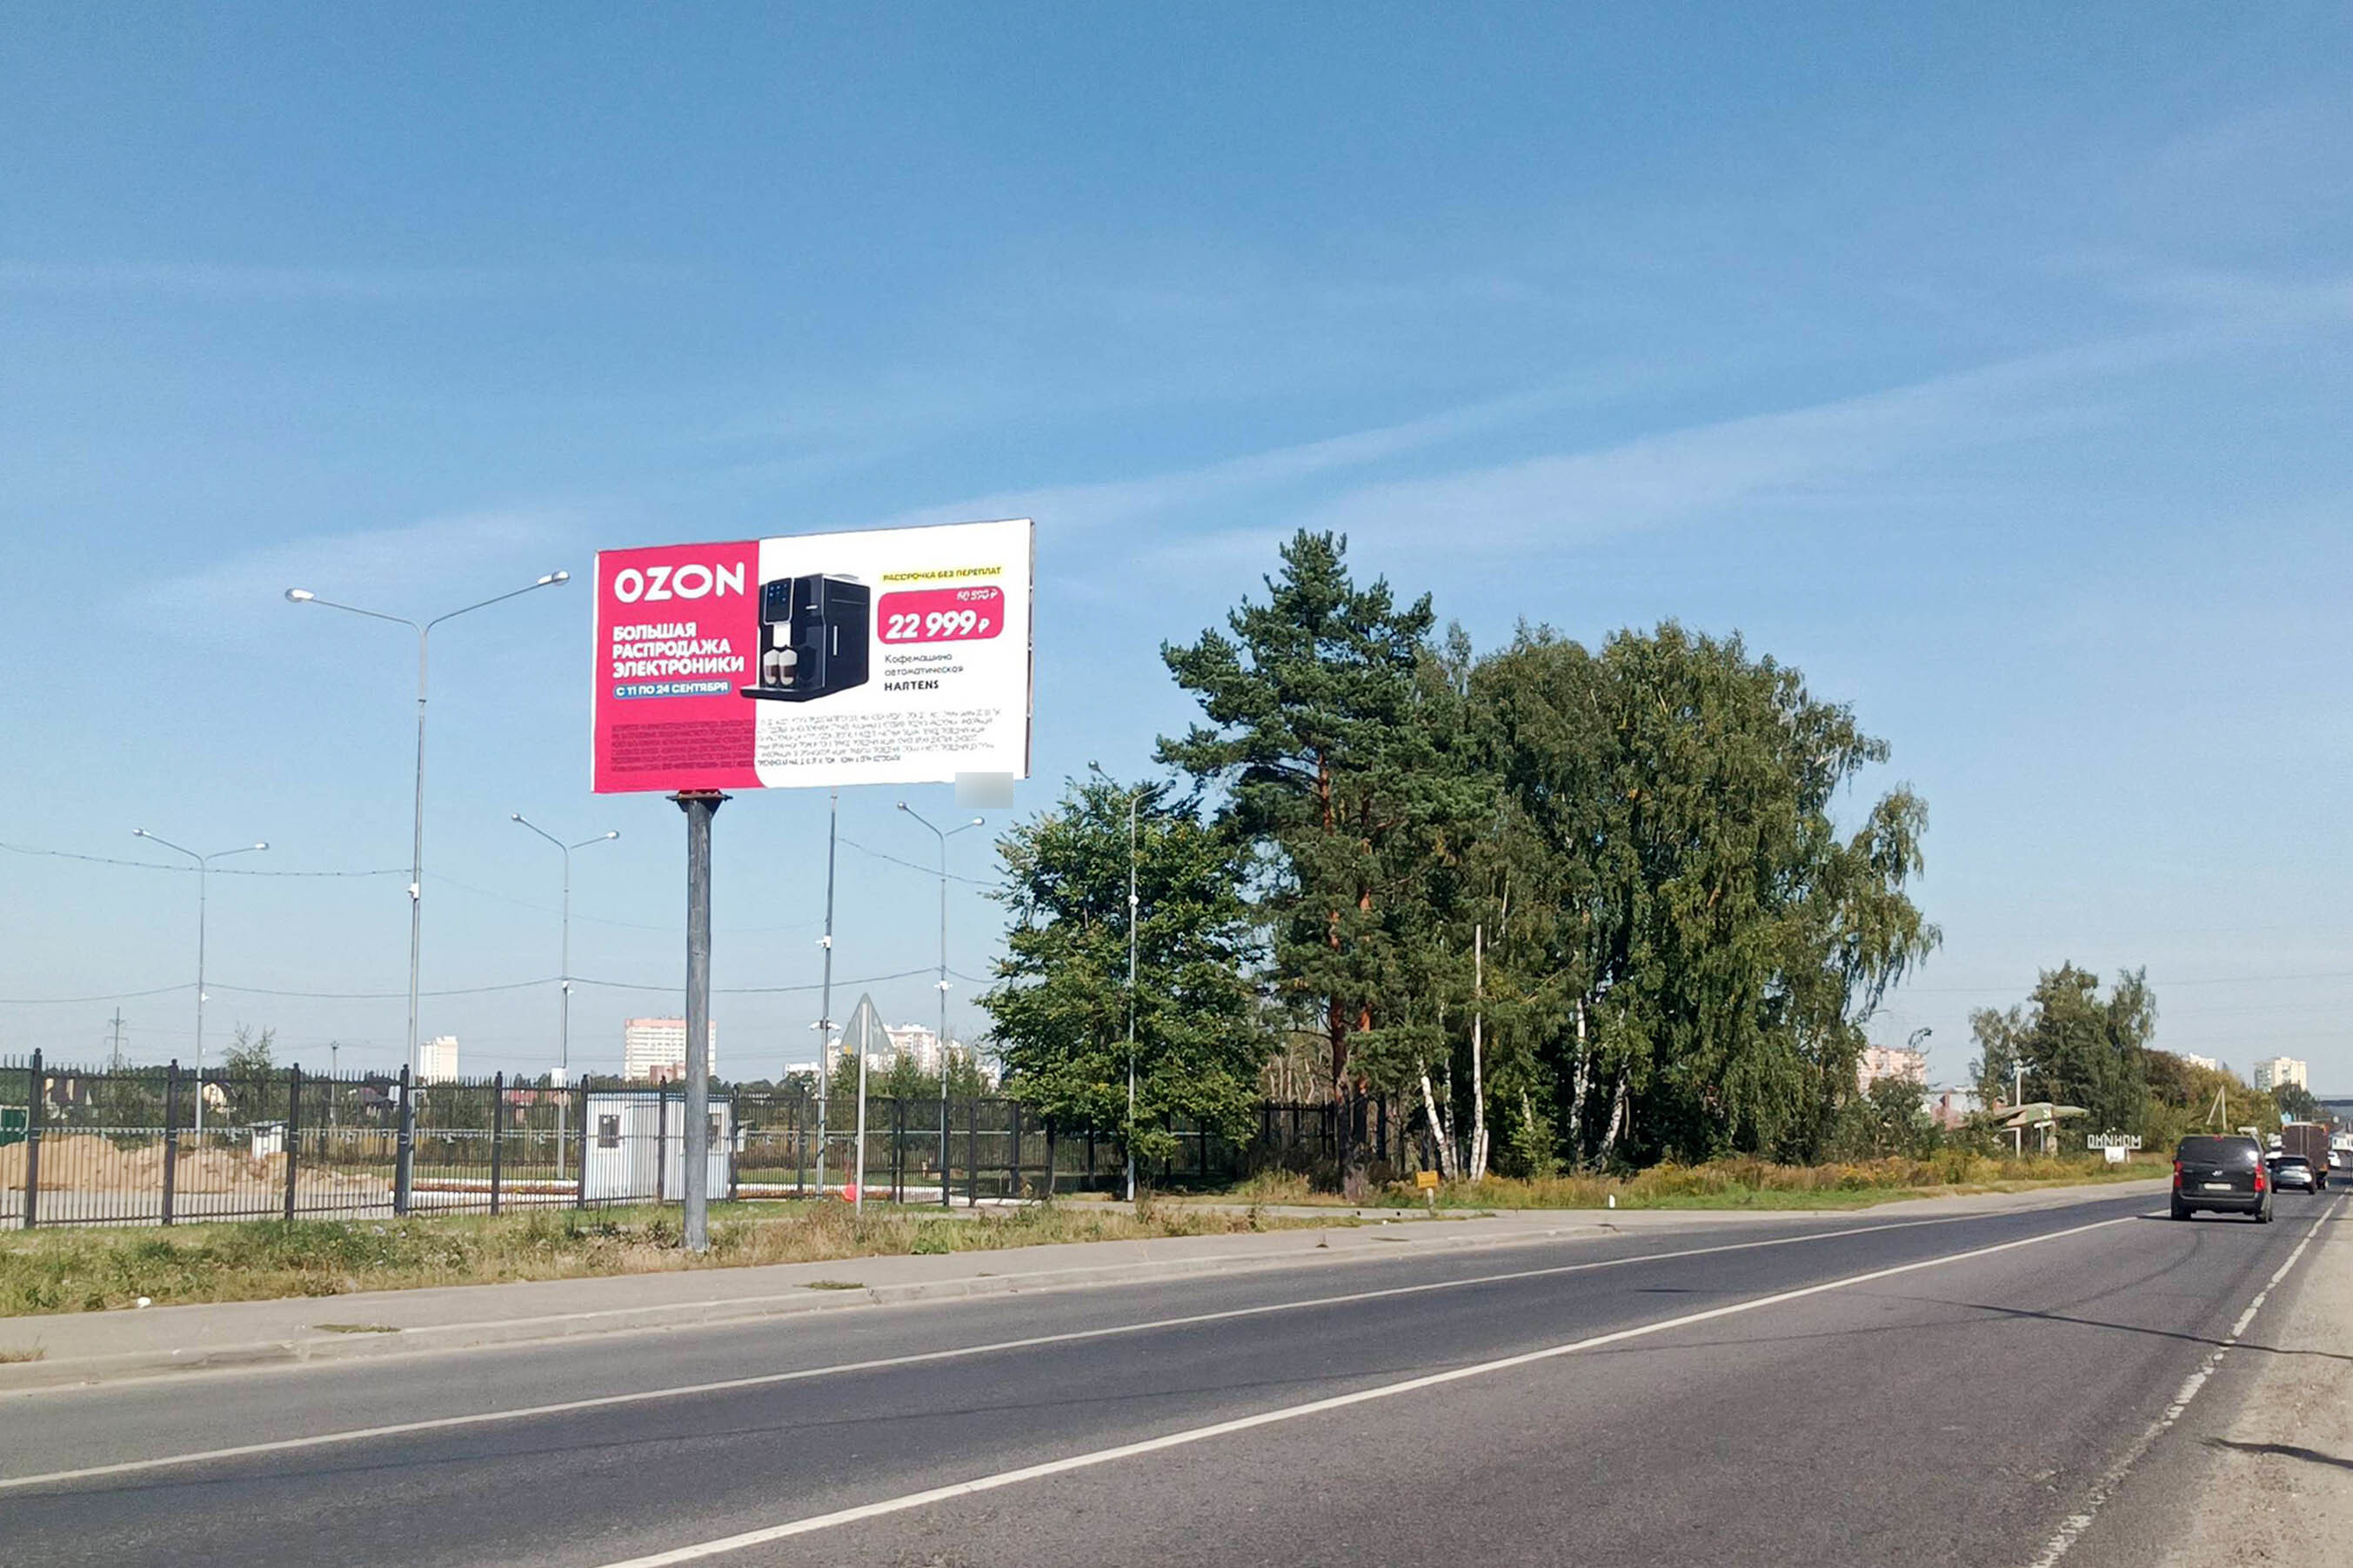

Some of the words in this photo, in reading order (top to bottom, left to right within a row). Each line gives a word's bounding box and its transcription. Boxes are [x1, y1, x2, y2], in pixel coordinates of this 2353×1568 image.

[614, 562, 745, 604] OZON
[612, 622, 697, 642] БОЛЬШАЯ
[885, 612, 921, 639] 22
[926, 610, 978, 638] 999
[612, 638, 732, 659] РАСПРОДАЖА
[612, 656, 745, 678] ЭЛЕКТРОНИКИ
[627, 685, 637, 696] 11
[638, 684, 656, 695] ПО
[657, 684, 670, 694] 24
[672, 681, 729, 694] СЕНТЯБРЯ
[884, 679, 939, 691] HARTENS
